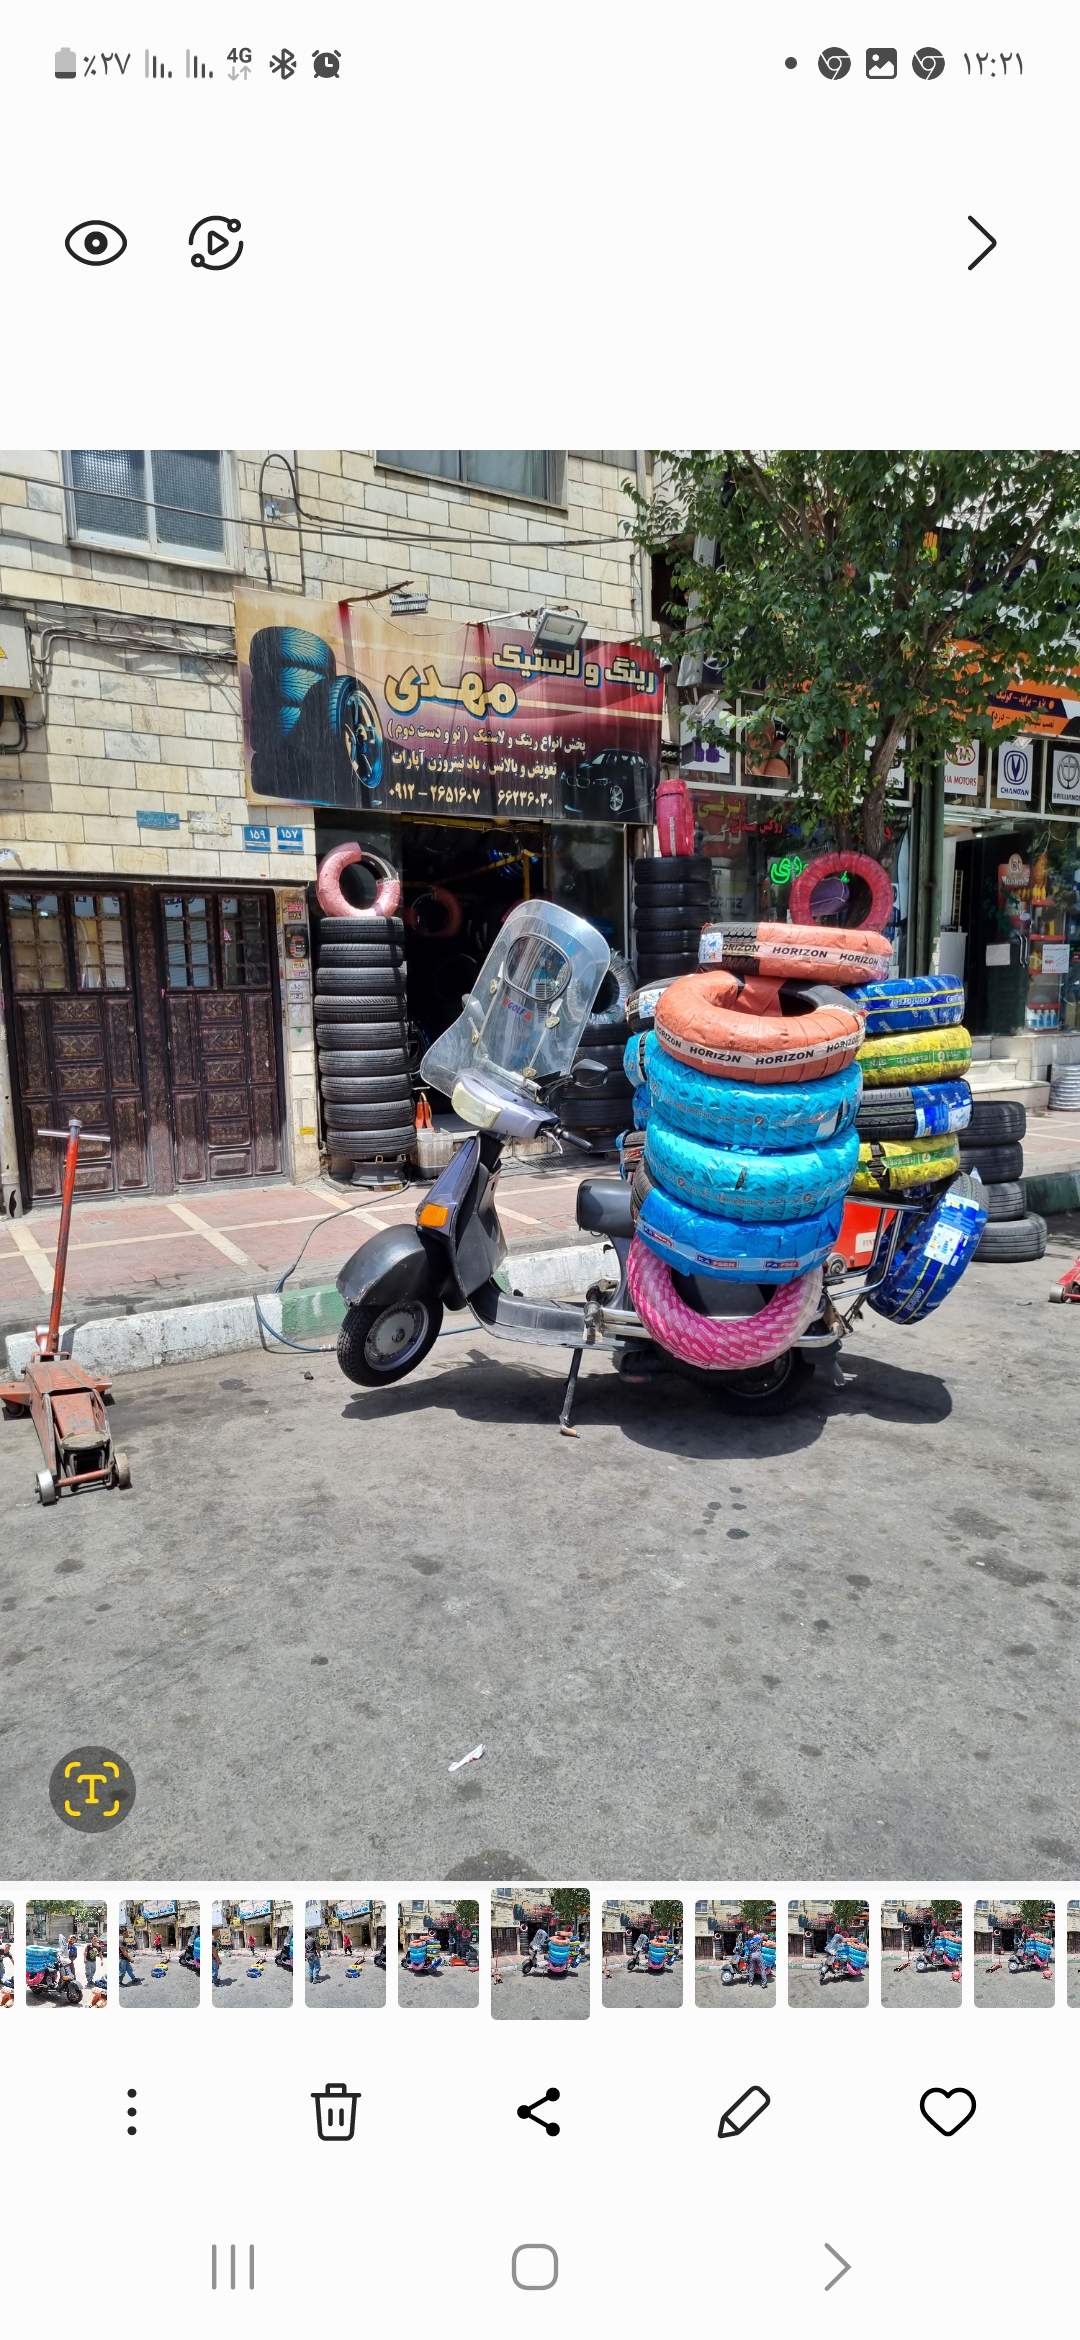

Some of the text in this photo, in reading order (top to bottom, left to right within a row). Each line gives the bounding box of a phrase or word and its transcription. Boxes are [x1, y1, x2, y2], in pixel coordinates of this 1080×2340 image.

[493, 643, 656, 694] رینگ و لاستیک
[384, 665, 517, 718] مهدی
[417, 724, 441, 738] دست
[443, 730, 450, 744] و
[473, 728, 505, 746] لاستیک
[507, 736, 513, 749] و
[515, 732, 538, 751] رینگ
[540, 735, 563, 752] انواع
[564, 737, 586, 755] پخش
[392, 748, 426, 770] آپارات
[428, 753, 465, 772] نیتروژن
[467, 754, 480, 773] باد
[489, 757, 518, 775] بالانس
[520, 764, 526, 777] و
[527, 760, 557, 780] تعویض
[953, 775, 977, 787] MOTORS
[389, 782, 415, 801] ۰۹۱۲
[430, 785, 481, 804] ۲۶۵۱۶۰۷
[497, 789, 553, 808] ۶۶۲۳۶۰۳۰
[250, 829, 266, 840] ۱۵۹
[281, 828, 298, 839] ۱۵۷
[722, 943, 760, 953] ORIZON
[772, 946, 828, 958] HORIZON
[839, 952, 878, 966] HORIZON
[507, 1002, 526, 1015] GOLF
[690, 1046, 741, 1063] HORIZON
[755, 1049, 814, 1066] HORIZON
